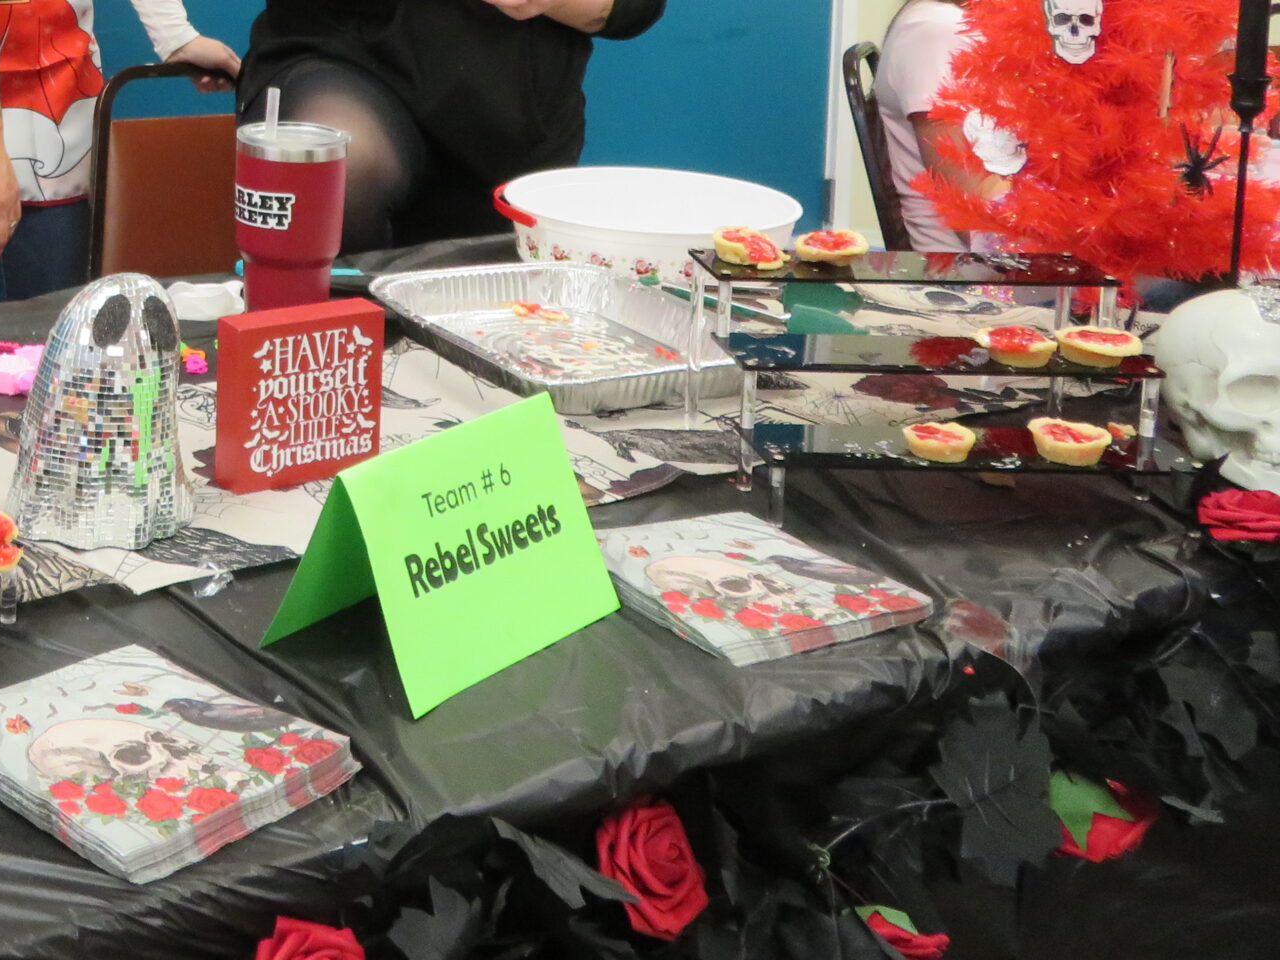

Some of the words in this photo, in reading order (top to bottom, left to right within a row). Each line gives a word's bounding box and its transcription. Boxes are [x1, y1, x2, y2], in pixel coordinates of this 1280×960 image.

[234, 206, 288, 227] KETT
[272, 328, 348, 376] HAVE
[257, 355, 369, 409] yourself
[262, 401, 280, 428] A
[286, 386, 364, 424] SPOOKY
[250, 430, 373, 473] Christmas
[289, 415, 342, 446] LITTLE
[421, 481, 478, 518] Team
[500, 462, 512, 486] 6
